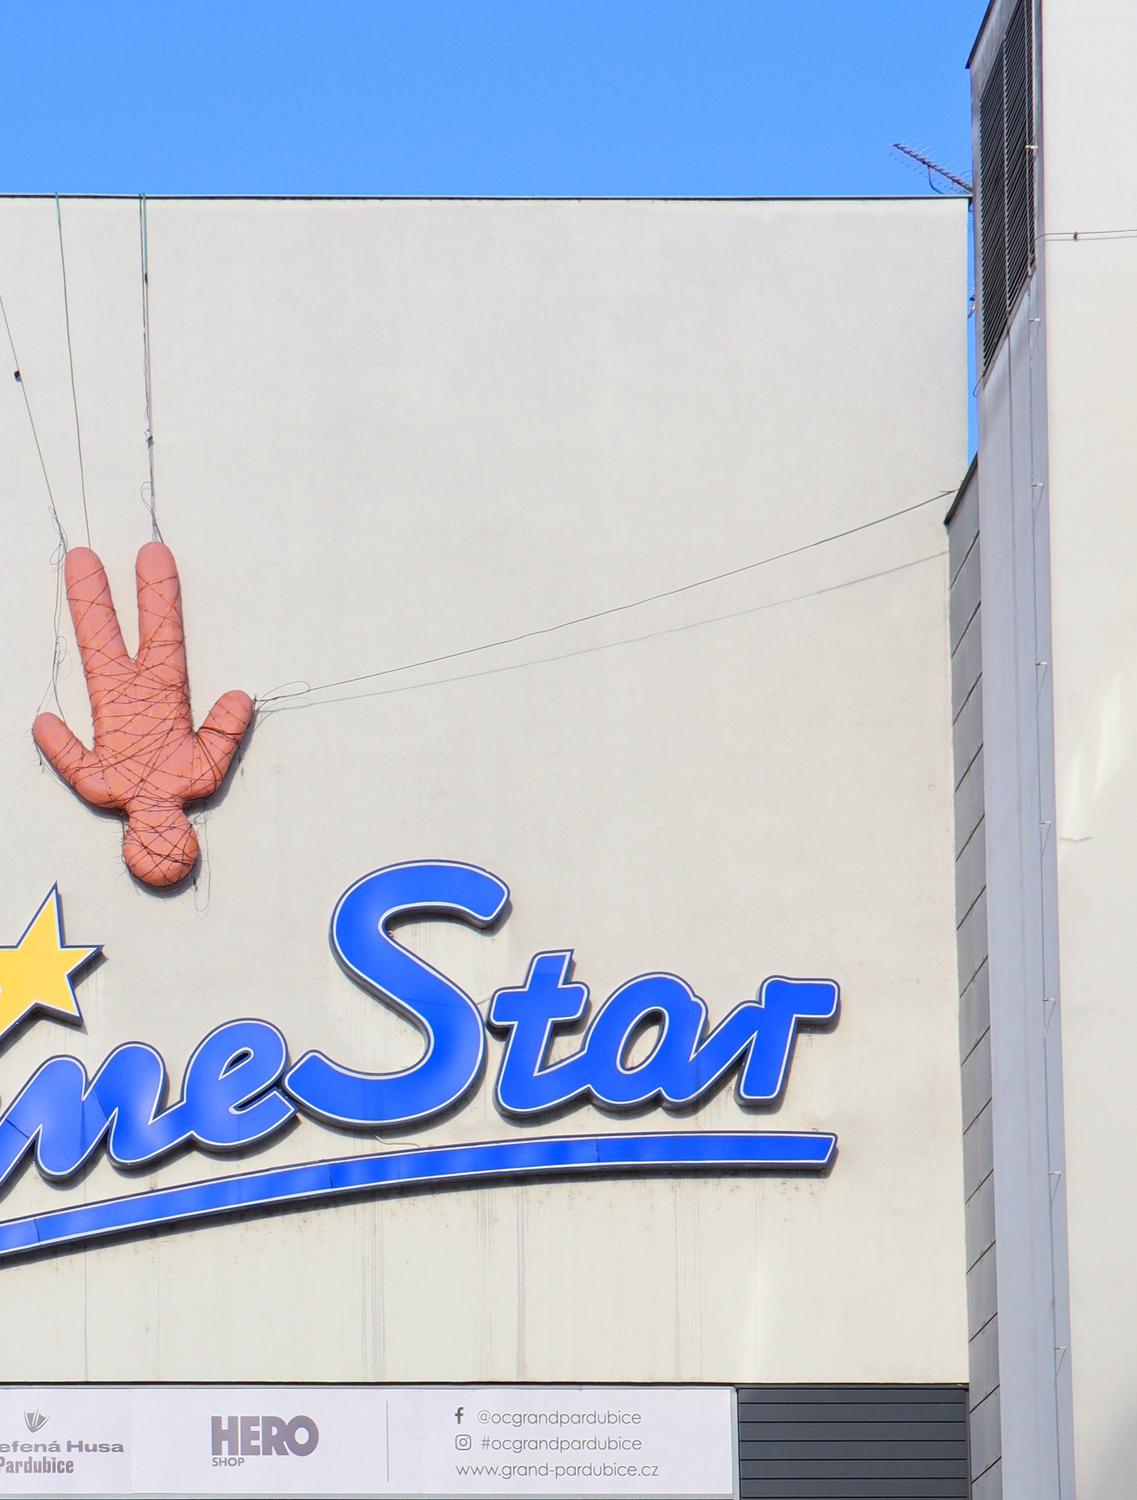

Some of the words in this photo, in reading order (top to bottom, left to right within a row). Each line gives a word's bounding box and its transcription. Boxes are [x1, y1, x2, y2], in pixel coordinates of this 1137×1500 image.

[477, 1409, 641, 1427] @ocgrandpardubice
[210, 1415, 319, 1457] HERO
[481, 1436, 642, 1454] #ocgrandpardubice
[66, 1440, 124, 1453] Husa
[211, 1457, 245, 1467] SHOP
[455, 1462, 659, 1480] www.grand-pardubice.cz
